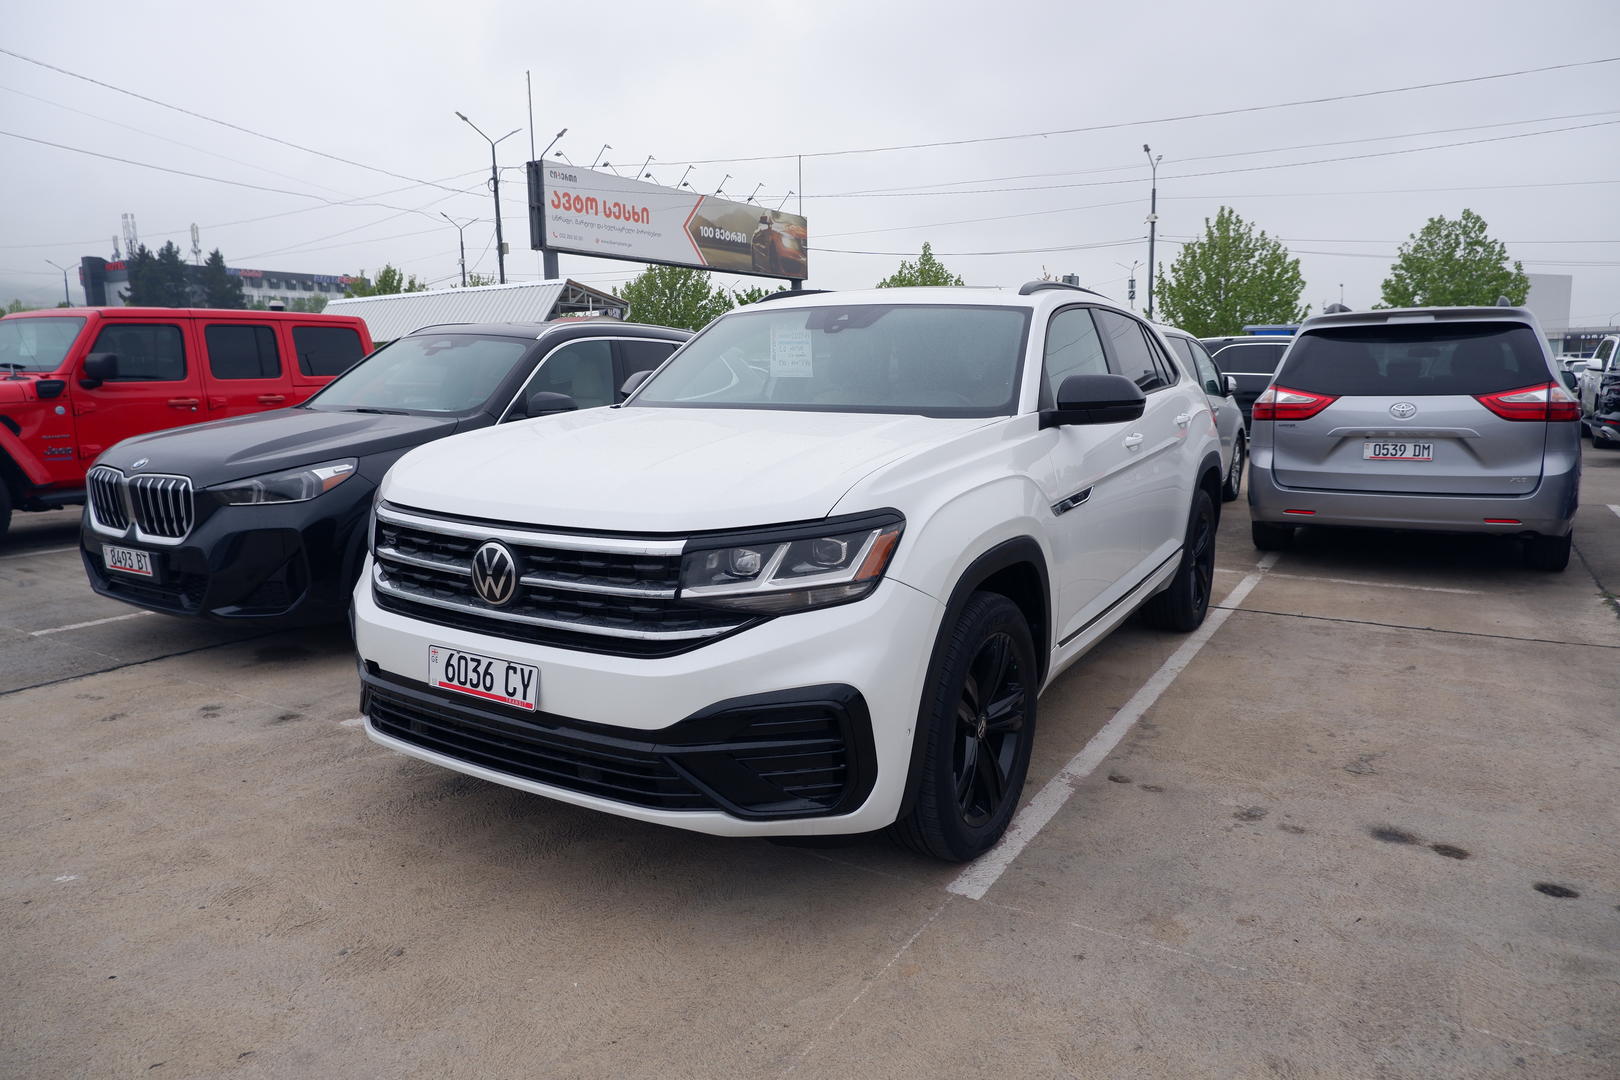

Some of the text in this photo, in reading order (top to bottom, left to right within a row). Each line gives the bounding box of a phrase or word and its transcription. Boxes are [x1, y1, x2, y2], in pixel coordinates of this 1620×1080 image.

[551, 190, 650, 225] ავტო სესხი
[700, 226, 714, 238] 100
[1373, 443, 1431, 457] 0539 DM
[110, 547, 148, 572] 8493 BT
[444, 653, 533, 700] 6036 CY
